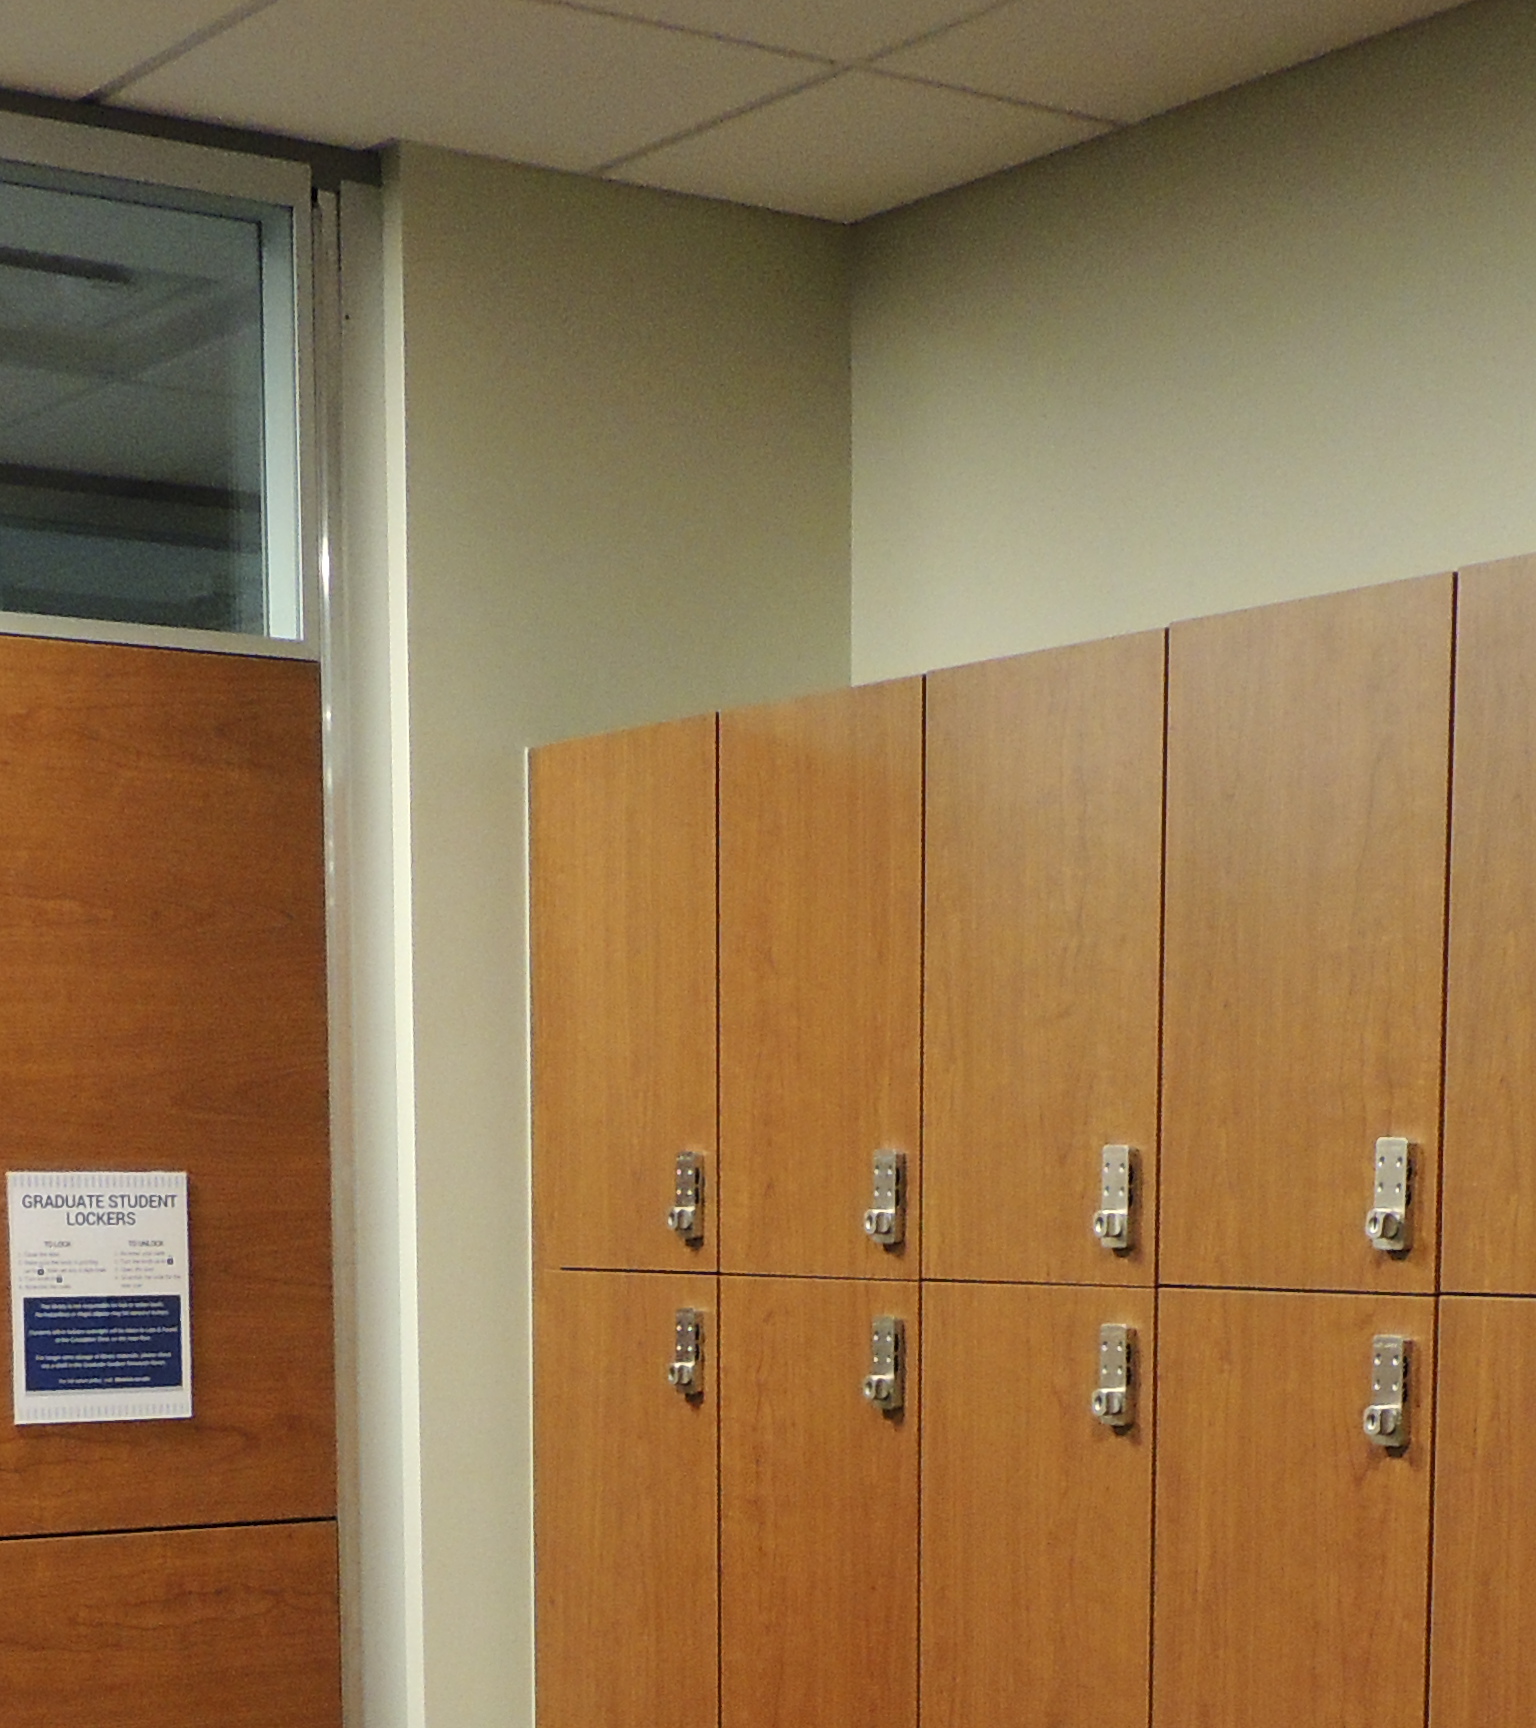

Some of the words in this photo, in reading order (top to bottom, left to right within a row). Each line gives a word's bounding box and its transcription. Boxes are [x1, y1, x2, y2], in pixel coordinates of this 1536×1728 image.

[21, 1194, 105, 1209] GRADUATE
[108, 1194, 178, 1209] STUDENT
[66, 1211, 137, 1226] LOCKERS
